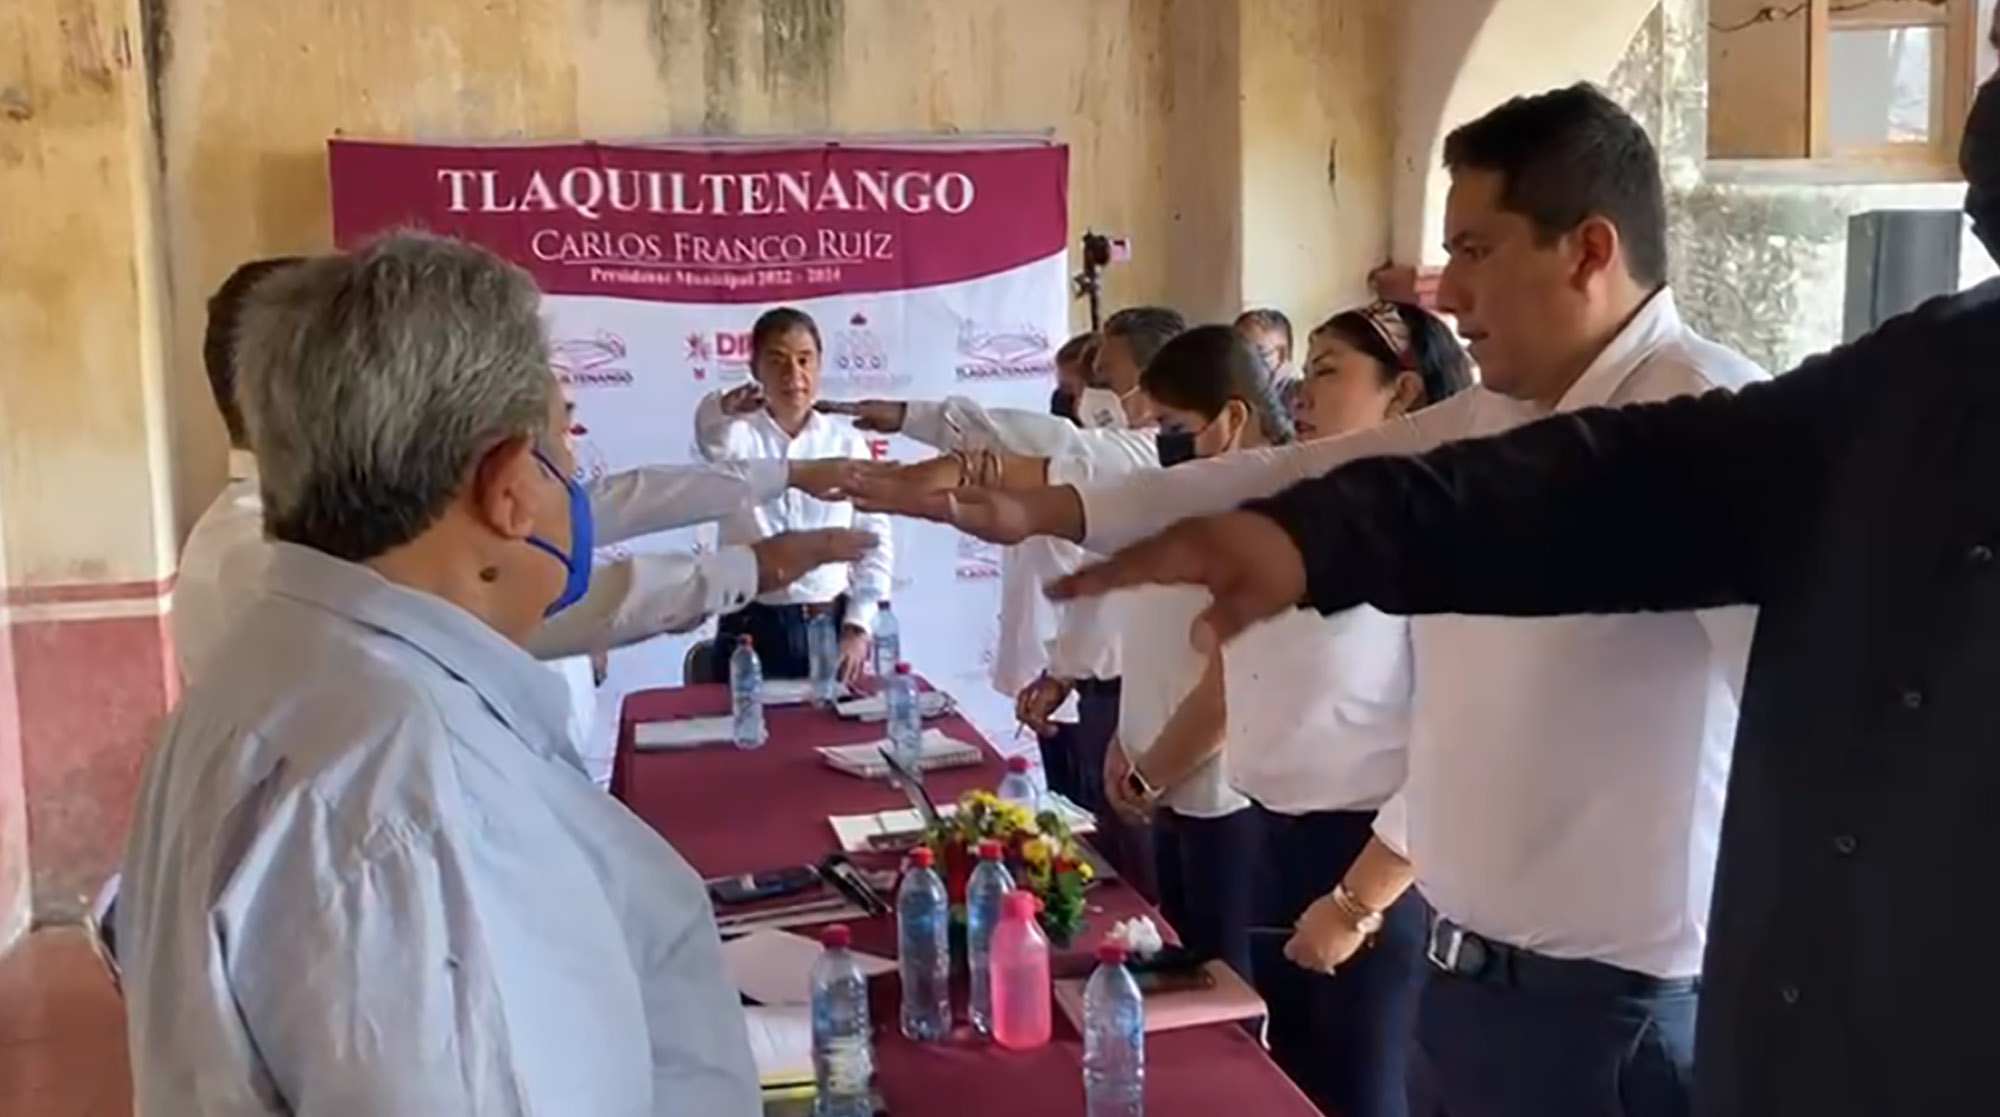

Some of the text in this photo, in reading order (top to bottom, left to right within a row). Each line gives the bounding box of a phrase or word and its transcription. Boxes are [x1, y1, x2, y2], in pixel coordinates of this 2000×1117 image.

[437, 166, 974, 219] TLAQUILTENANGO
[532, 229, 661, 260] CARLOS
[674, 232, 807, 262] FRANCO
